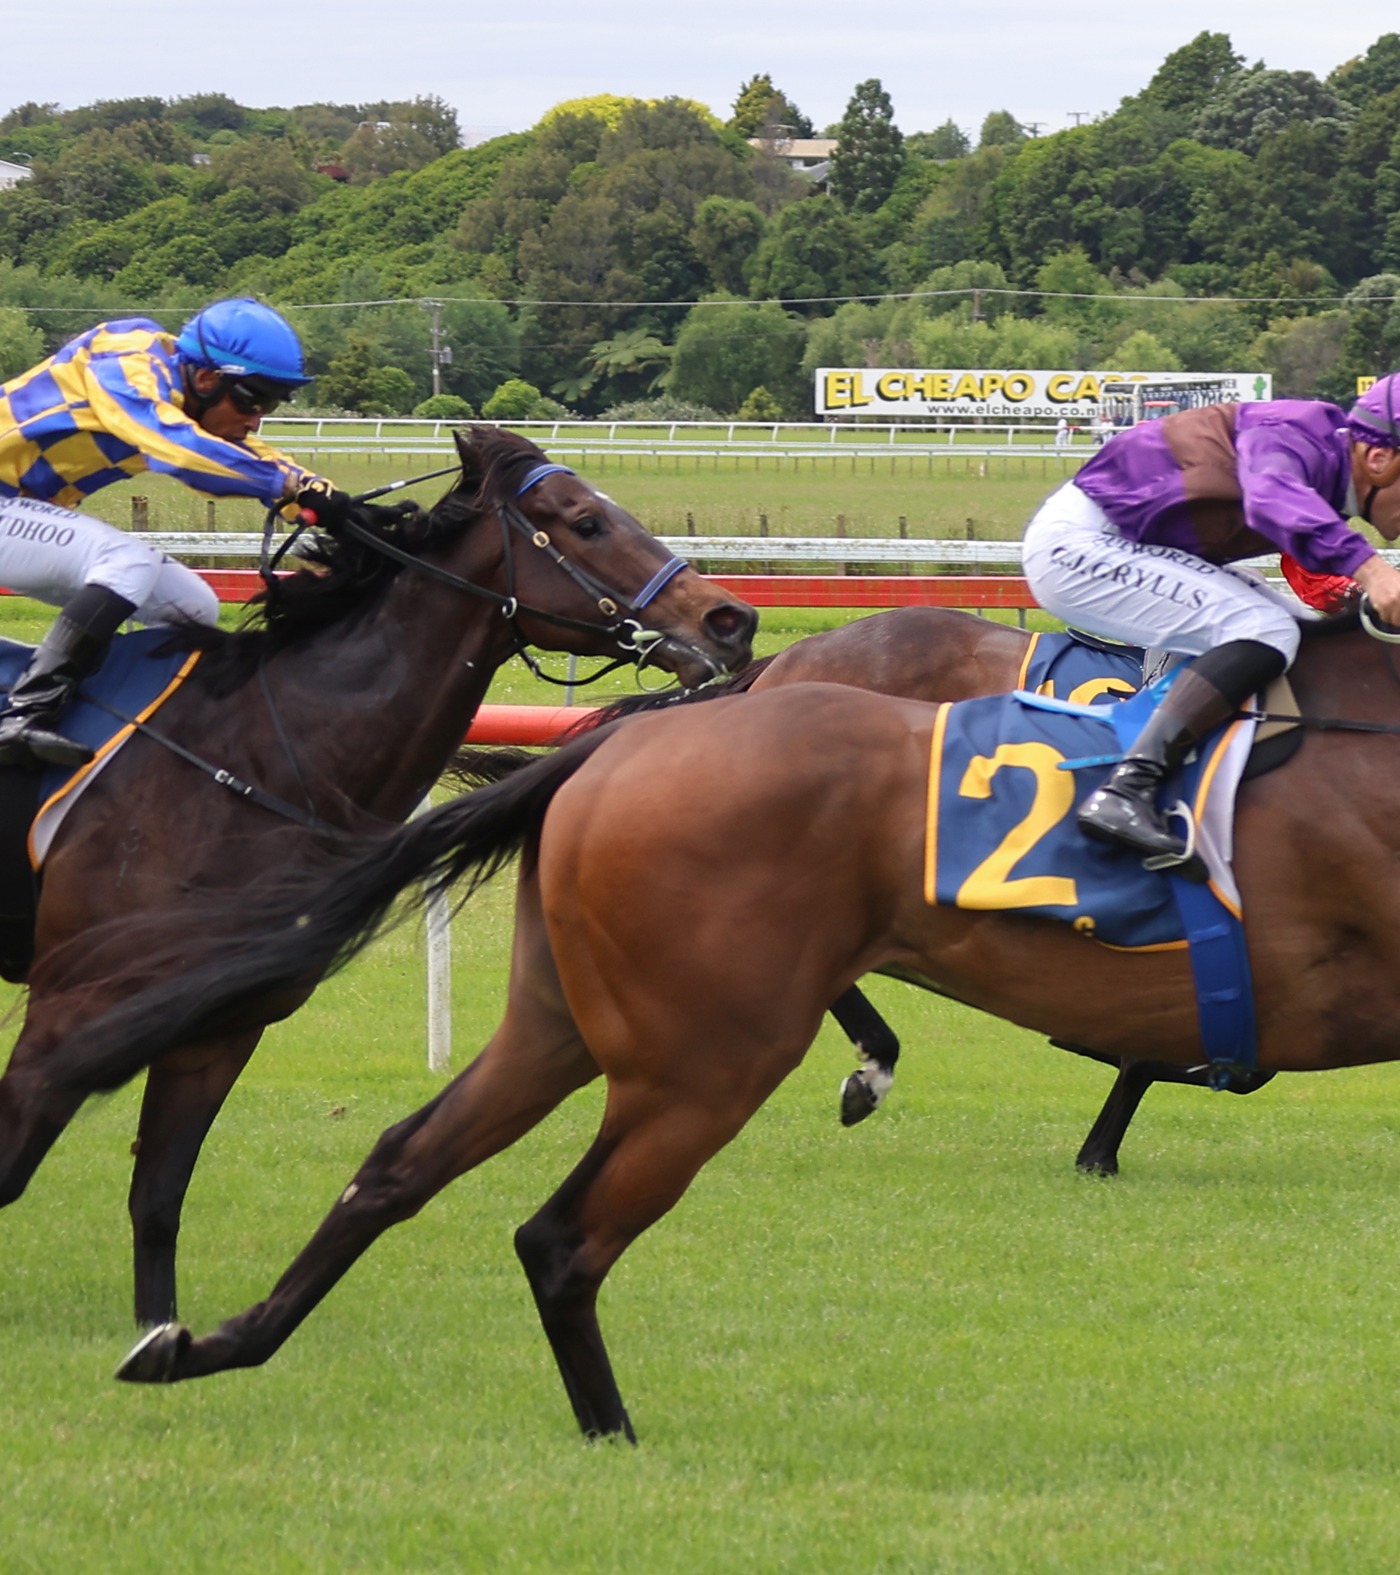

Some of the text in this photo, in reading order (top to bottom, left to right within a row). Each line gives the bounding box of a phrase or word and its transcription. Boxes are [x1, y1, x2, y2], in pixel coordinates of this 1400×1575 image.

[825, 372, 874, 410] EL
[876, 372, 1036, 403] CHEAPO
[926, 402, 1099, 417] www.elcheapo.co.n
[0, 515, 75, 547] DHOO
[957, 741, 1079, 911] 2
